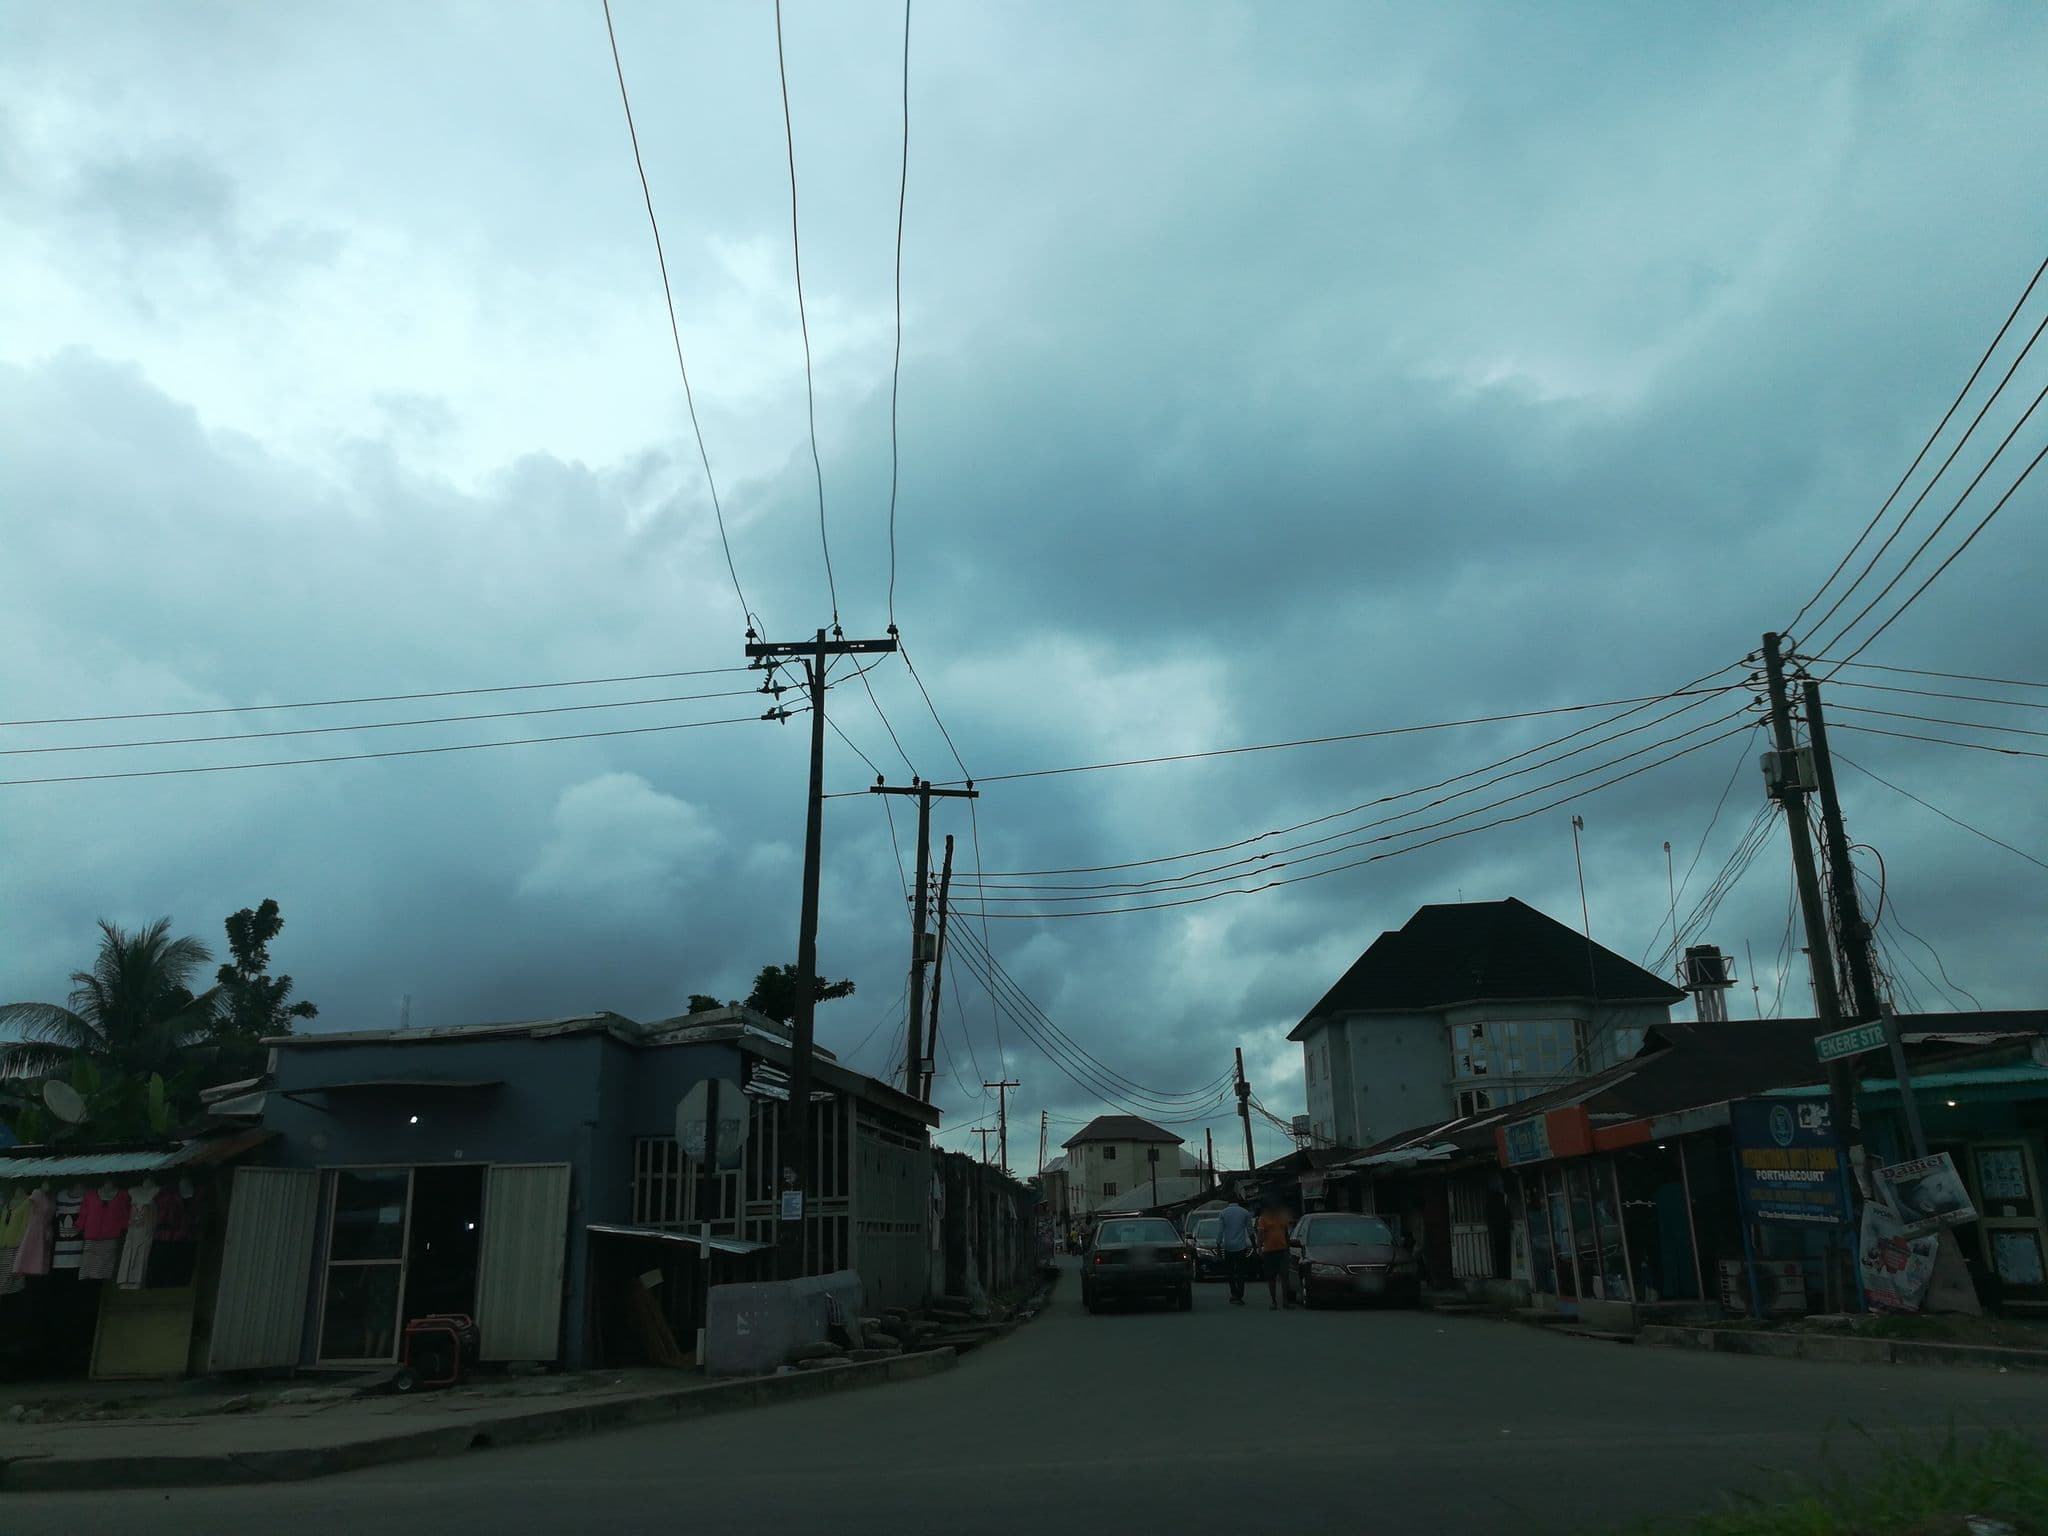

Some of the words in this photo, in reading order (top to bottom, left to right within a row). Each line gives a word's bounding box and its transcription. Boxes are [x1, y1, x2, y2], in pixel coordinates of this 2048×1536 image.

[1821, 1033, 1858, 1056] EKERE
[1860, 1026, 1885, 1046] STR
[1756, 1170, 1825, 1182] PORTHARCOURT
